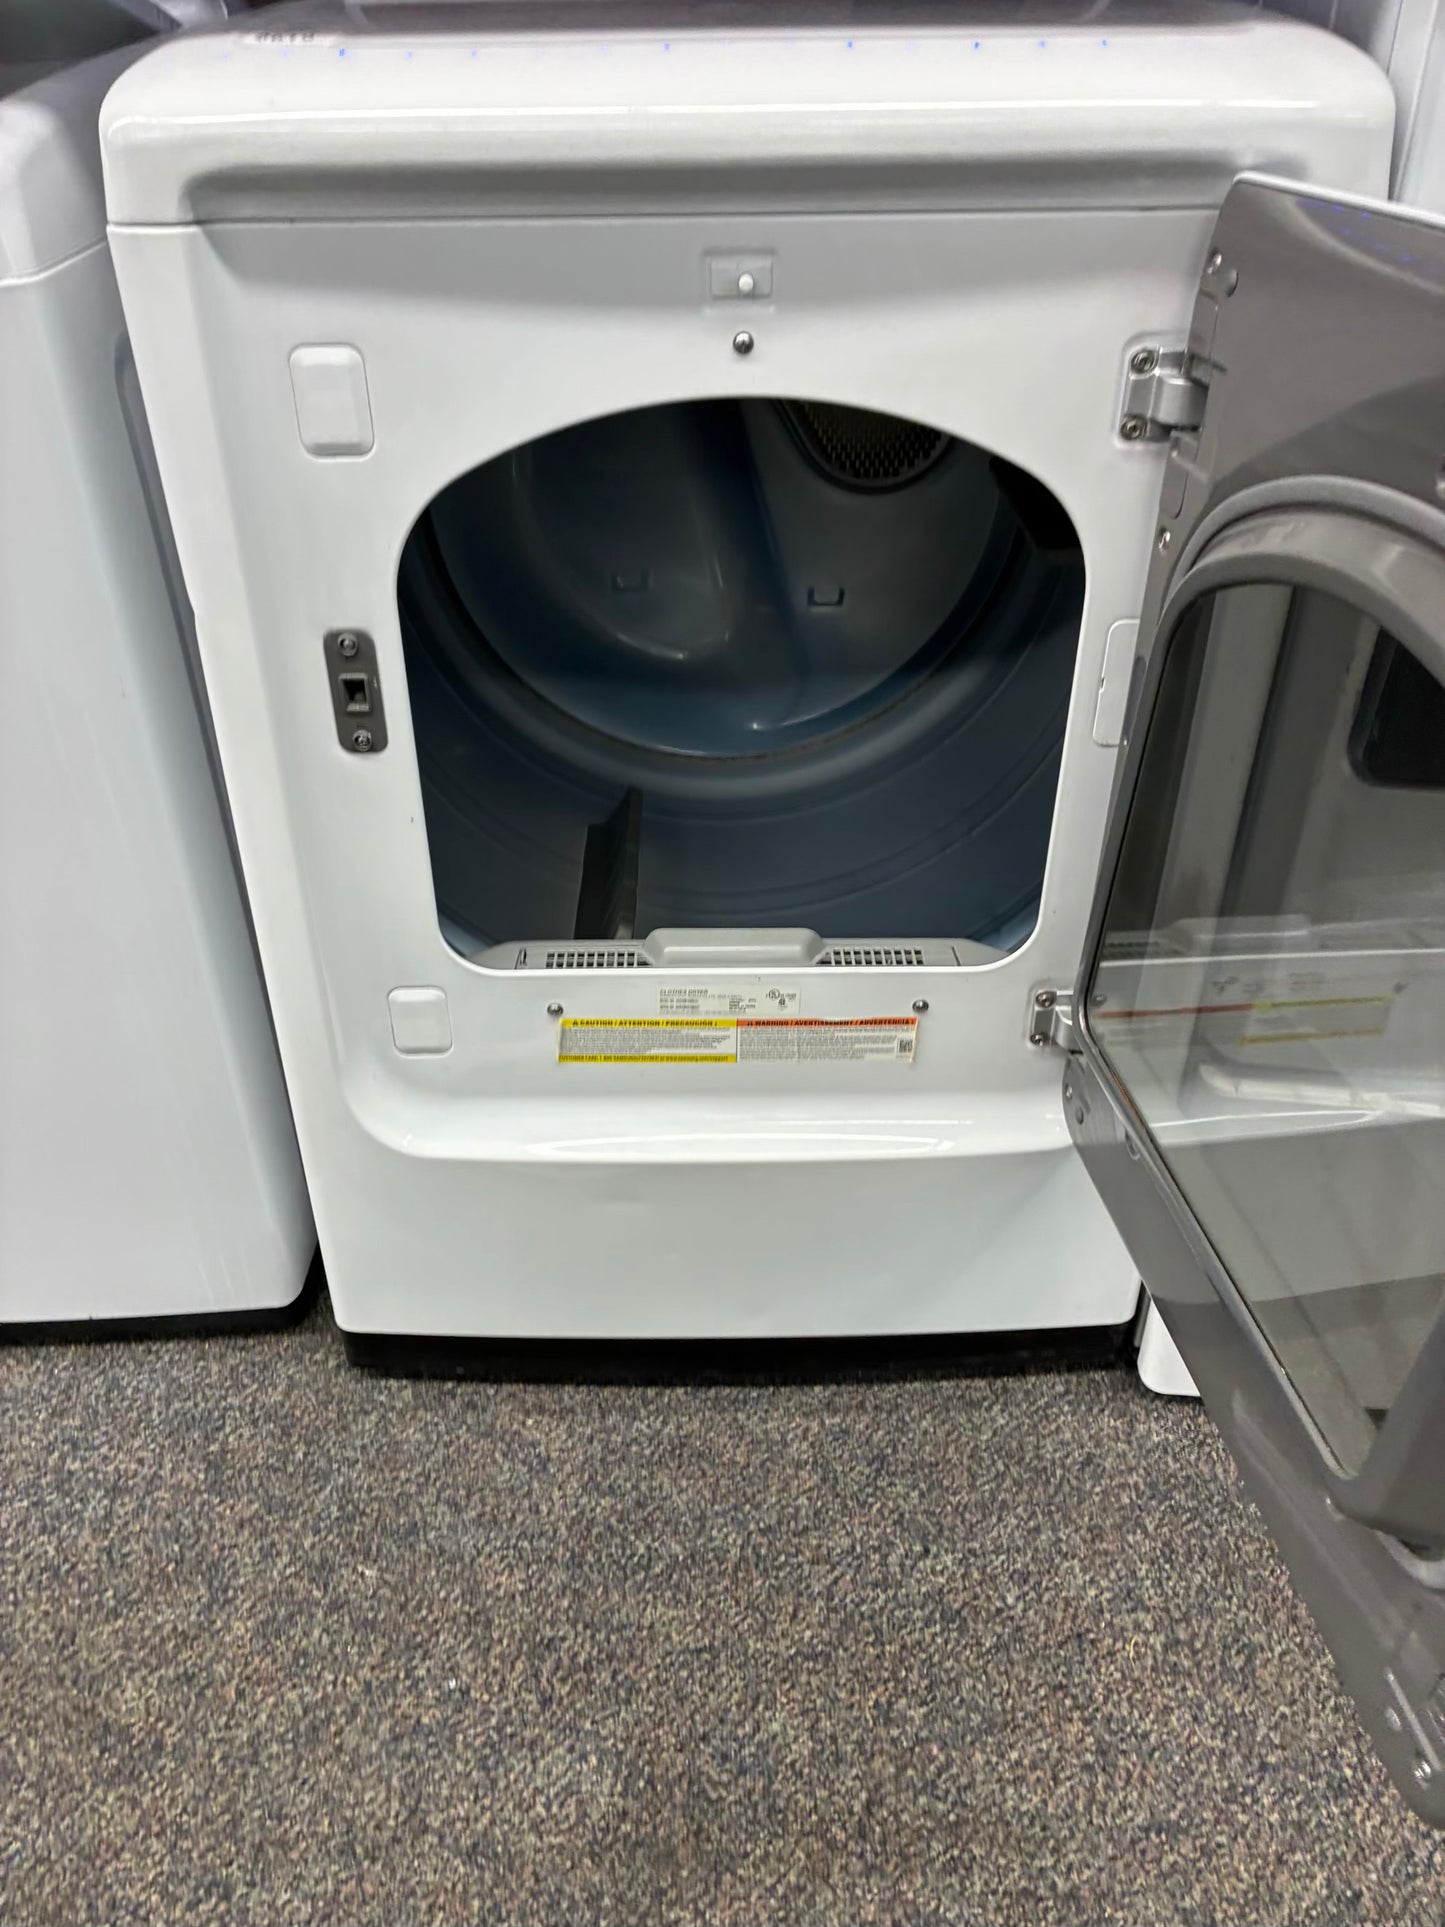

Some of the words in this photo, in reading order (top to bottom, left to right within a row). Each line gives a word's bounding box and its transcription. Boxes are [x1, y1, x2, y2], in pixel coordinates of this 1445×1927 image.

[579, 1019, 613, 1027] CAUTION
[618, 1019, 660, 1027] ATTENTION
[754, 1019, 789, 1027] WARNING
